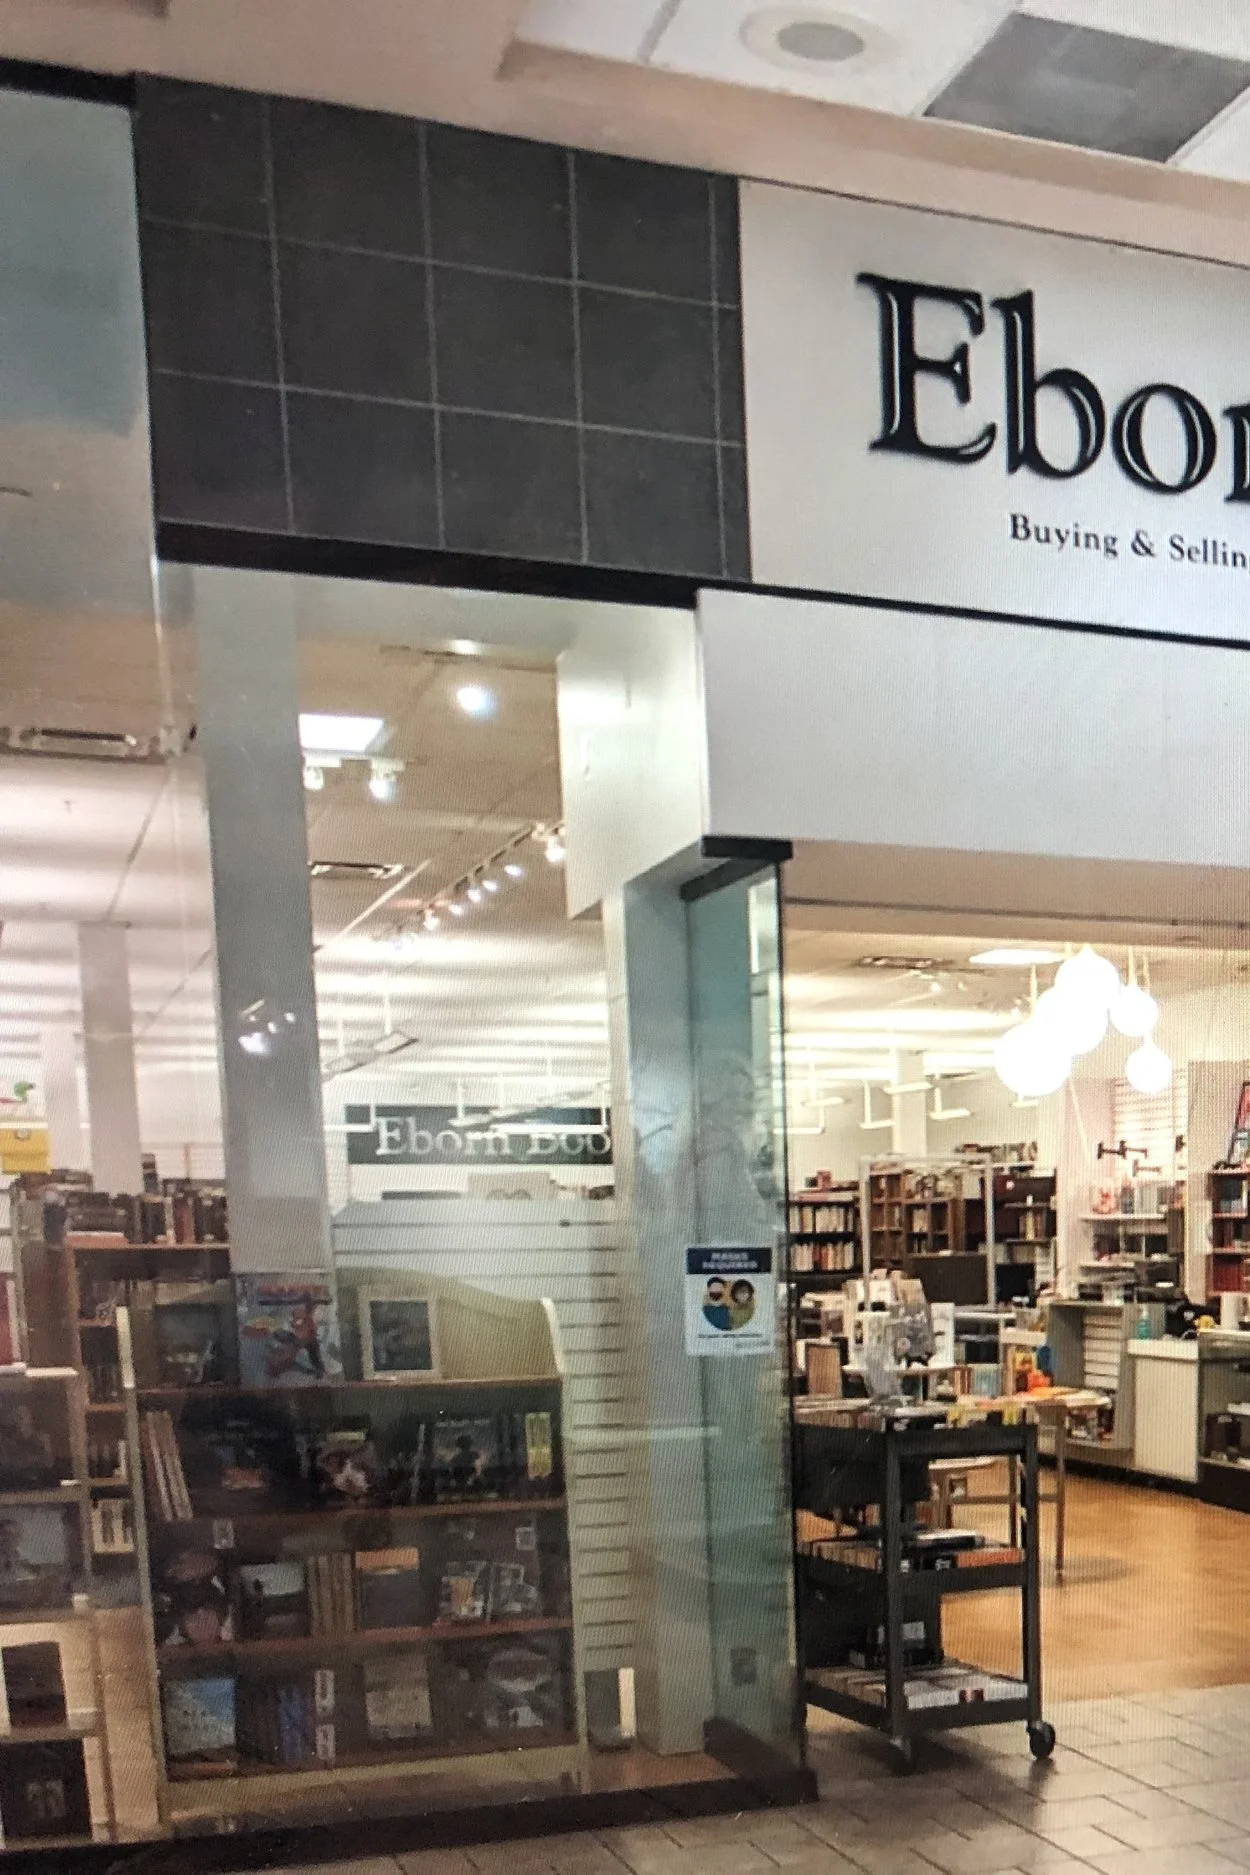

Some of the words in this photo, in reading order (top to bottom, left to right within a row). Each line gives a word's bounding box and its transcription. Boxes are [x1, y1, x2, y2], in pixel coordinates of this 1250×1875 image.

[1010, 513, 1119, 559] Buying
[1130, 529, 1156, 558] &
[376, 1115, 511, 1157] Eborn
